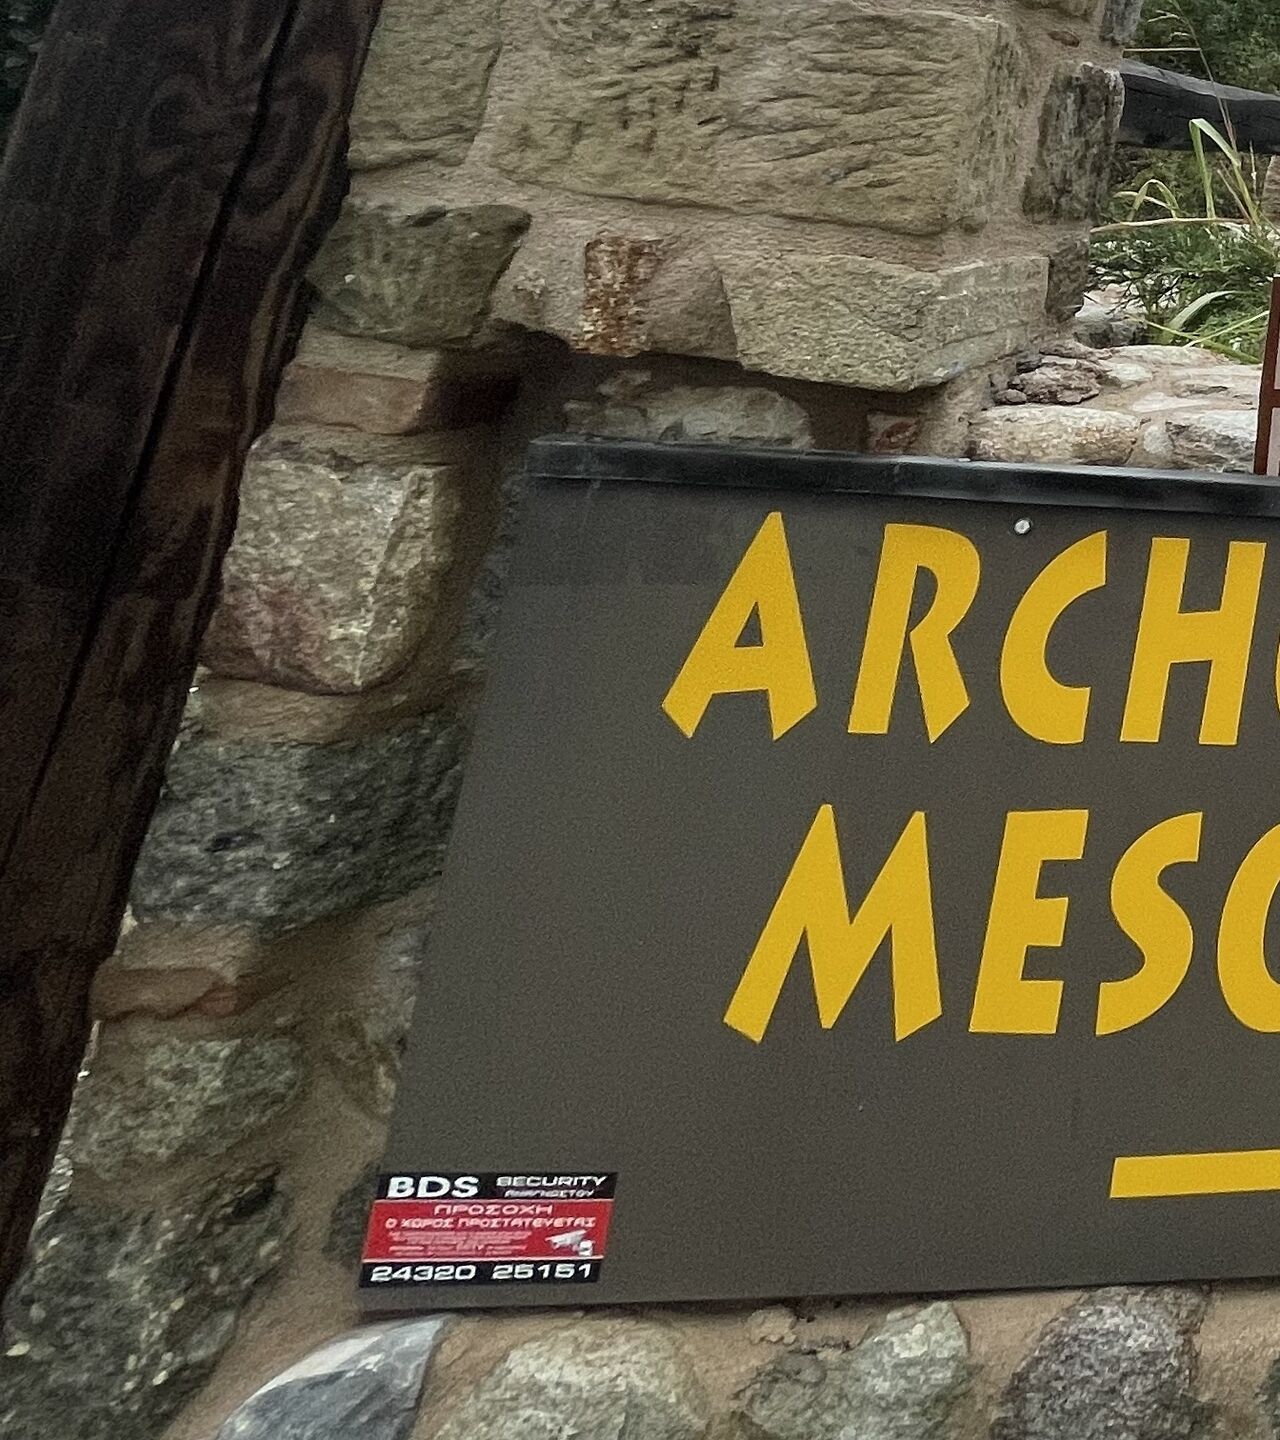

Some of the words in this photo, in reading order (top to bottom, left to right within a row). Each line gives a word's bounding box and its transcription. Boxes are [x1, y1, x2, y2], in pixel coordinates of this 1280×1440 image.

[386, 1176, 480, 1198] BDS
[495, 1175, 608, 1187] SECURITY
[433, 1204, 554, 1216] ΠΡΟΣΟΧΗ
[370, 1264, 477, 1282] 24320
[491, 1263, 593, 1280] 25151
